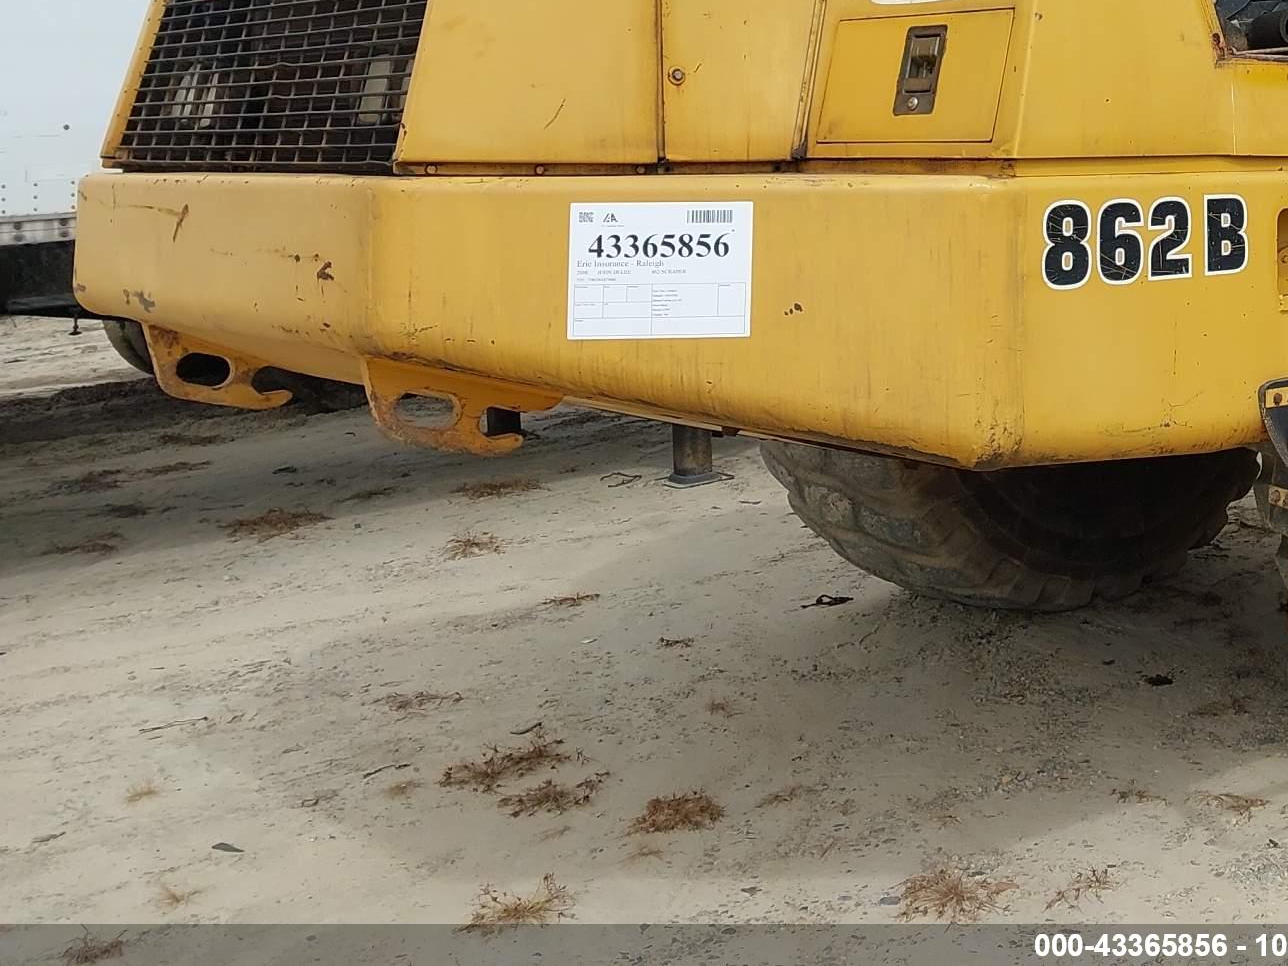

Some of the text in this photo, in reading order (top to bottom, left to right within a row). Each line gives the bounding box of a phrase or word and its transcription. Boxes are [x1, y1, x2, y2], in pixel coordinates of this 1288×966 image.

[588, 233, 731, 259] 43365856
[594, 260, 630, 268] Insurance
[636, 259, 664, 269] Raleigh
